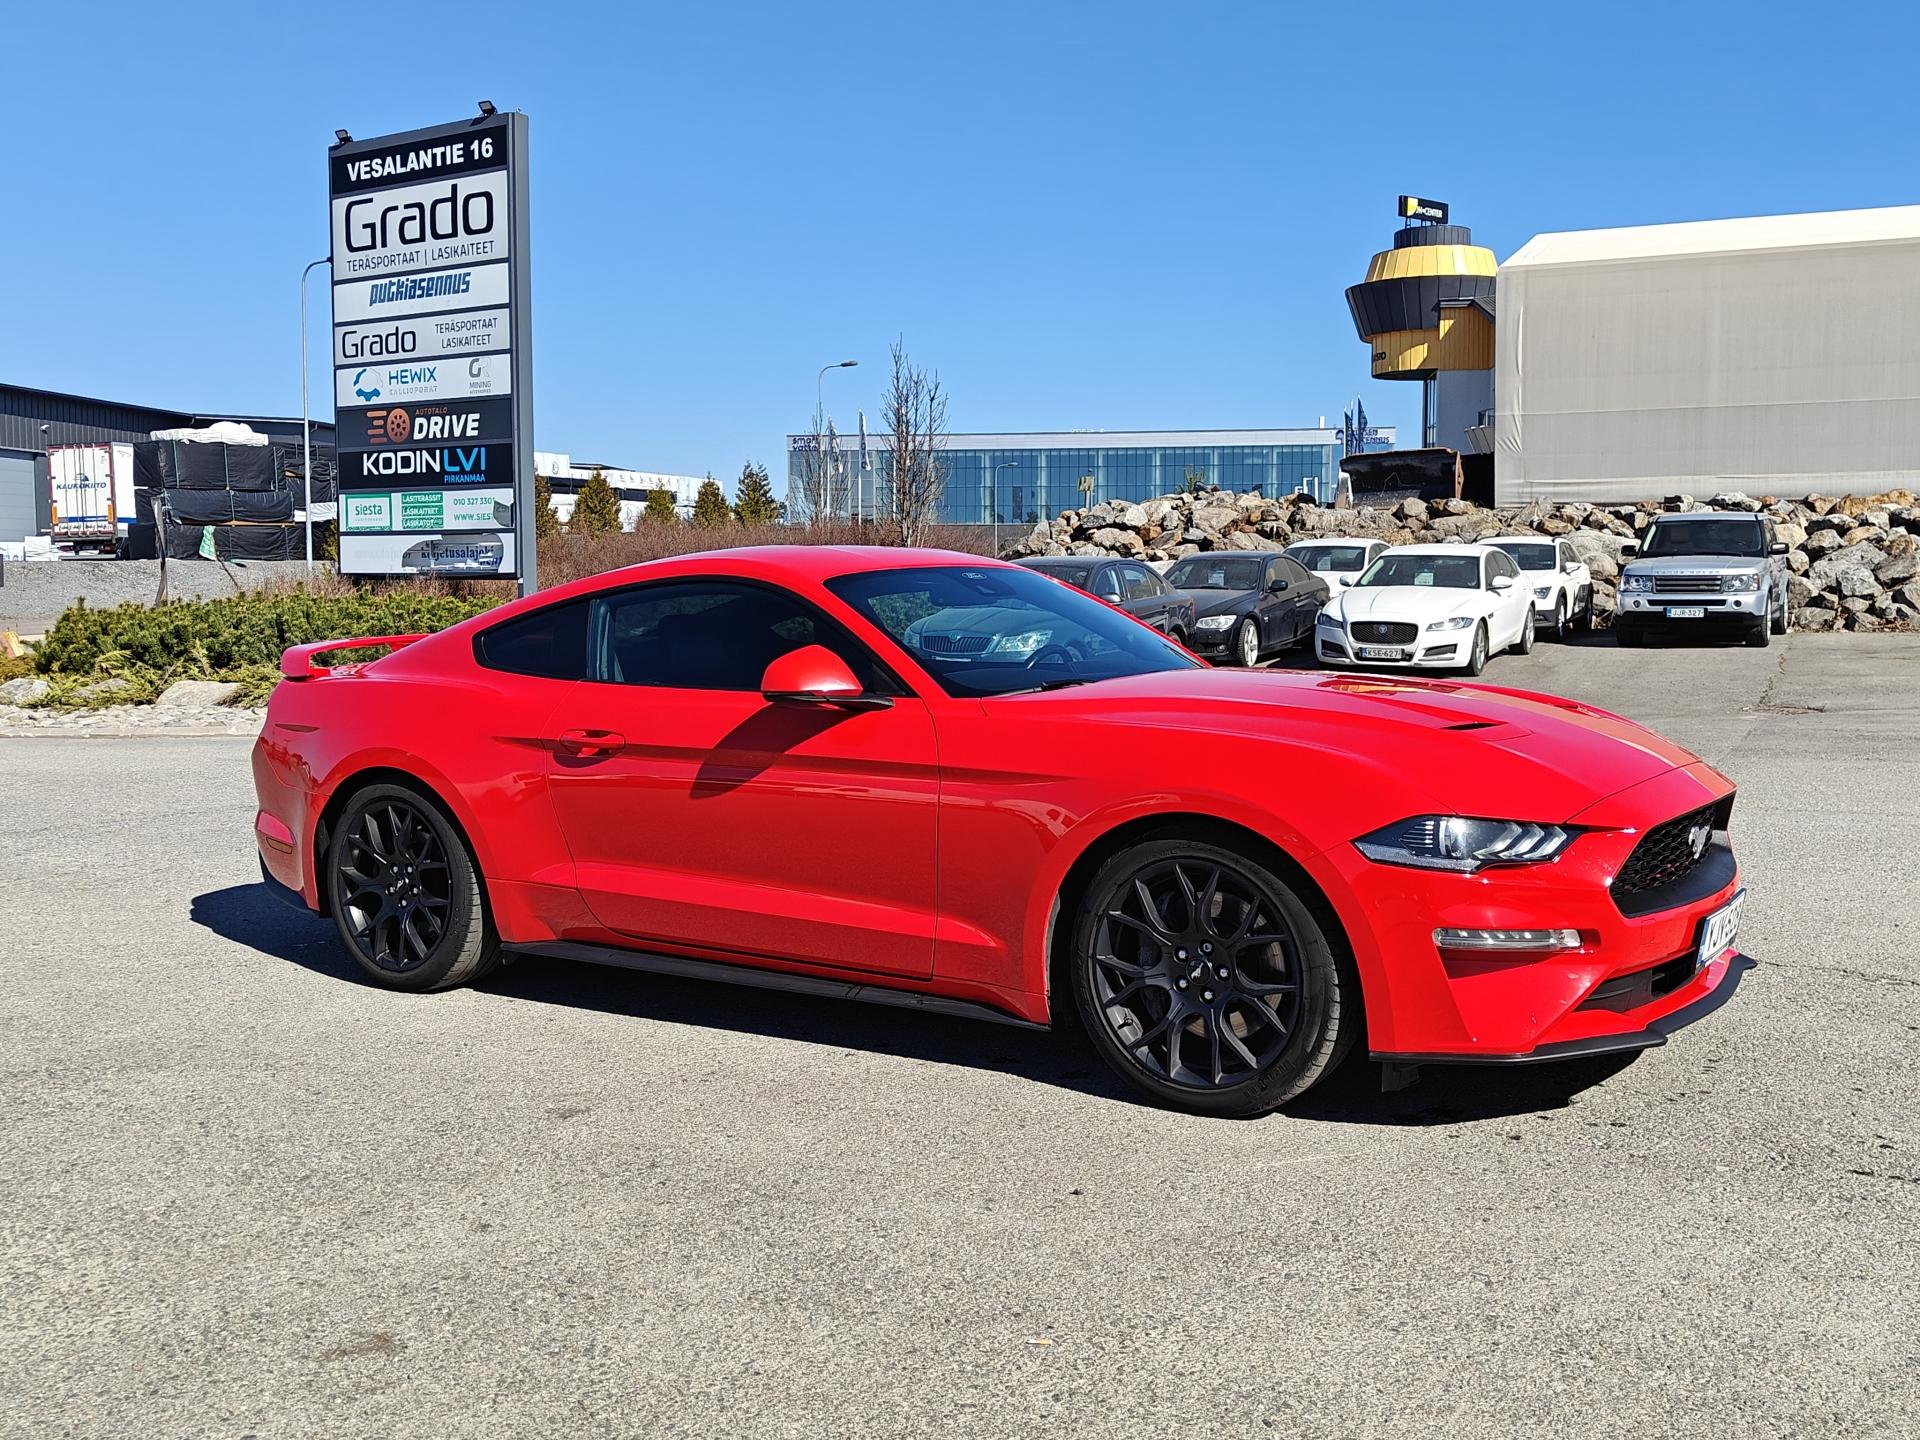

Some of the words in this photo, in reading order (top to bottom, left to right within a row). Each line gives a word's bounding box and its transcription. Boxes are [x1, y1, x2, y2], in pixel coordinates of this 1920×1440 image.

[346, 142, 464, 182] VESALANTIE
[470, 137, 493, 161] 16
[344, 183, 494, 253] Grado
[346, 249, 421, 273] TERÄSPORTAAT
[431, 240, 495, 261] LASIKAITEET
[369, 271, 471, 307] putkiasennus
[435, 317, 498, 335] TERÄSPORTAAT
[342, 326, 416, 359] Grado
[441, 334, 492, 349] LASIKAITEET
[388, 366, 437, 386] HEWIX
[415, 406, 448, 415] AUTOTALO
[413, 413, 480, 441] DRIVE
[444, 473, 486, 484] PIRKANMAA
[355, 503, 383, 516] siesta
[453, 498, 466, 506] 010
[467, 497, 478, 505] 327
[479, 497, 495, 505] 330
